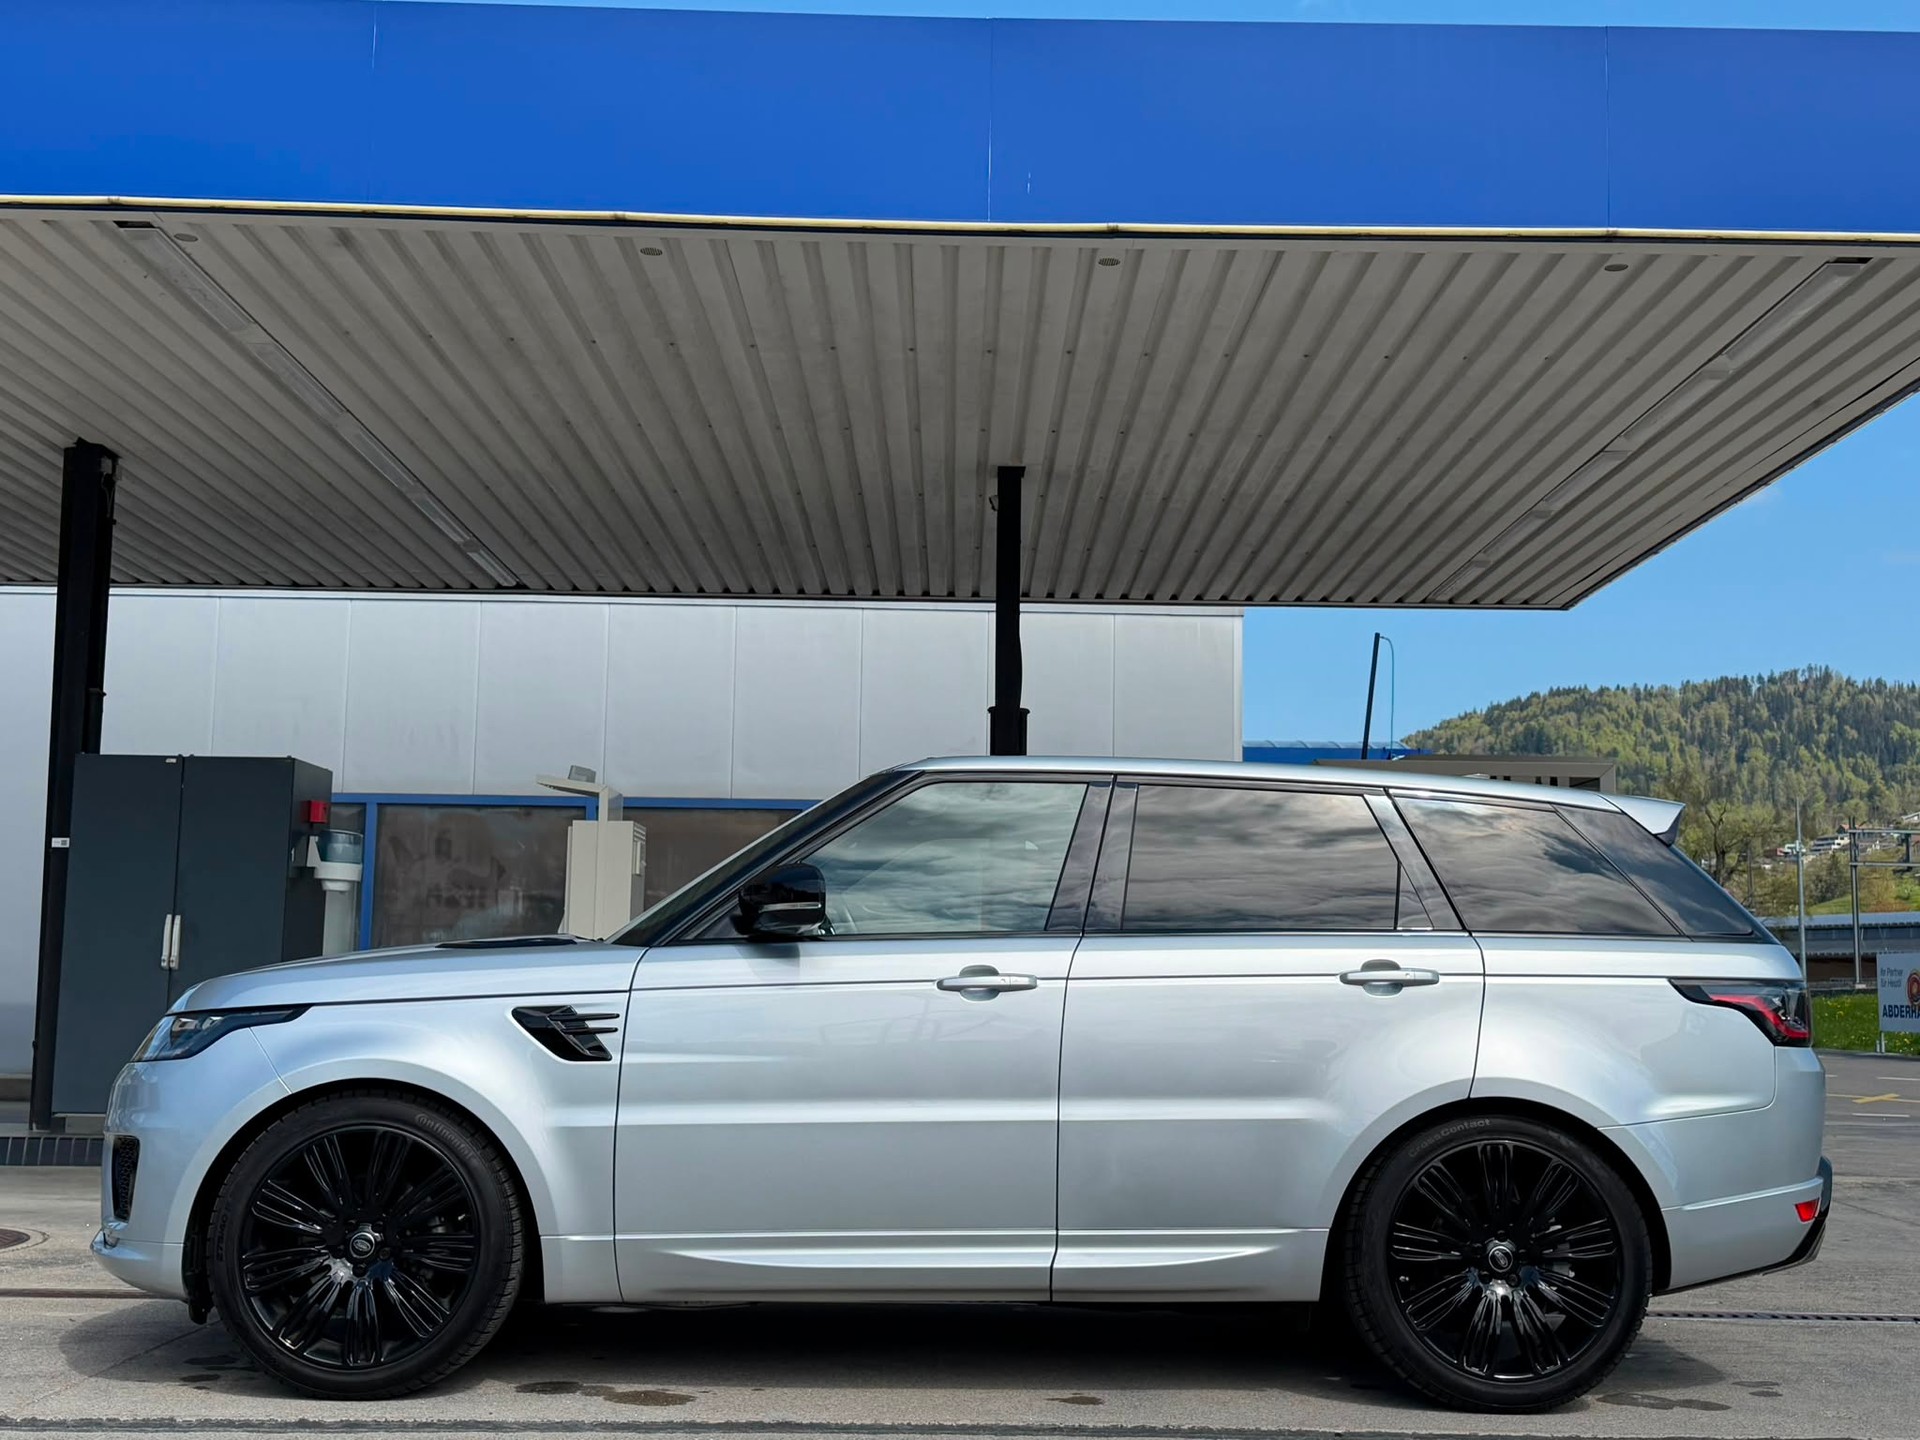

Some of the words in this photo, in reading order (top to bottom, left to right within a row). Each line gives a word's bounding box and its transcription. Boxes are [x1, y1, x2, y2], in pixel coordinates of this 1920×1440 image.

[1887, 968, 1903, 976] Partner
[415, 1113, 474, 1160] Continental
[1407, 1118, 1491, 1158] CrossContact
